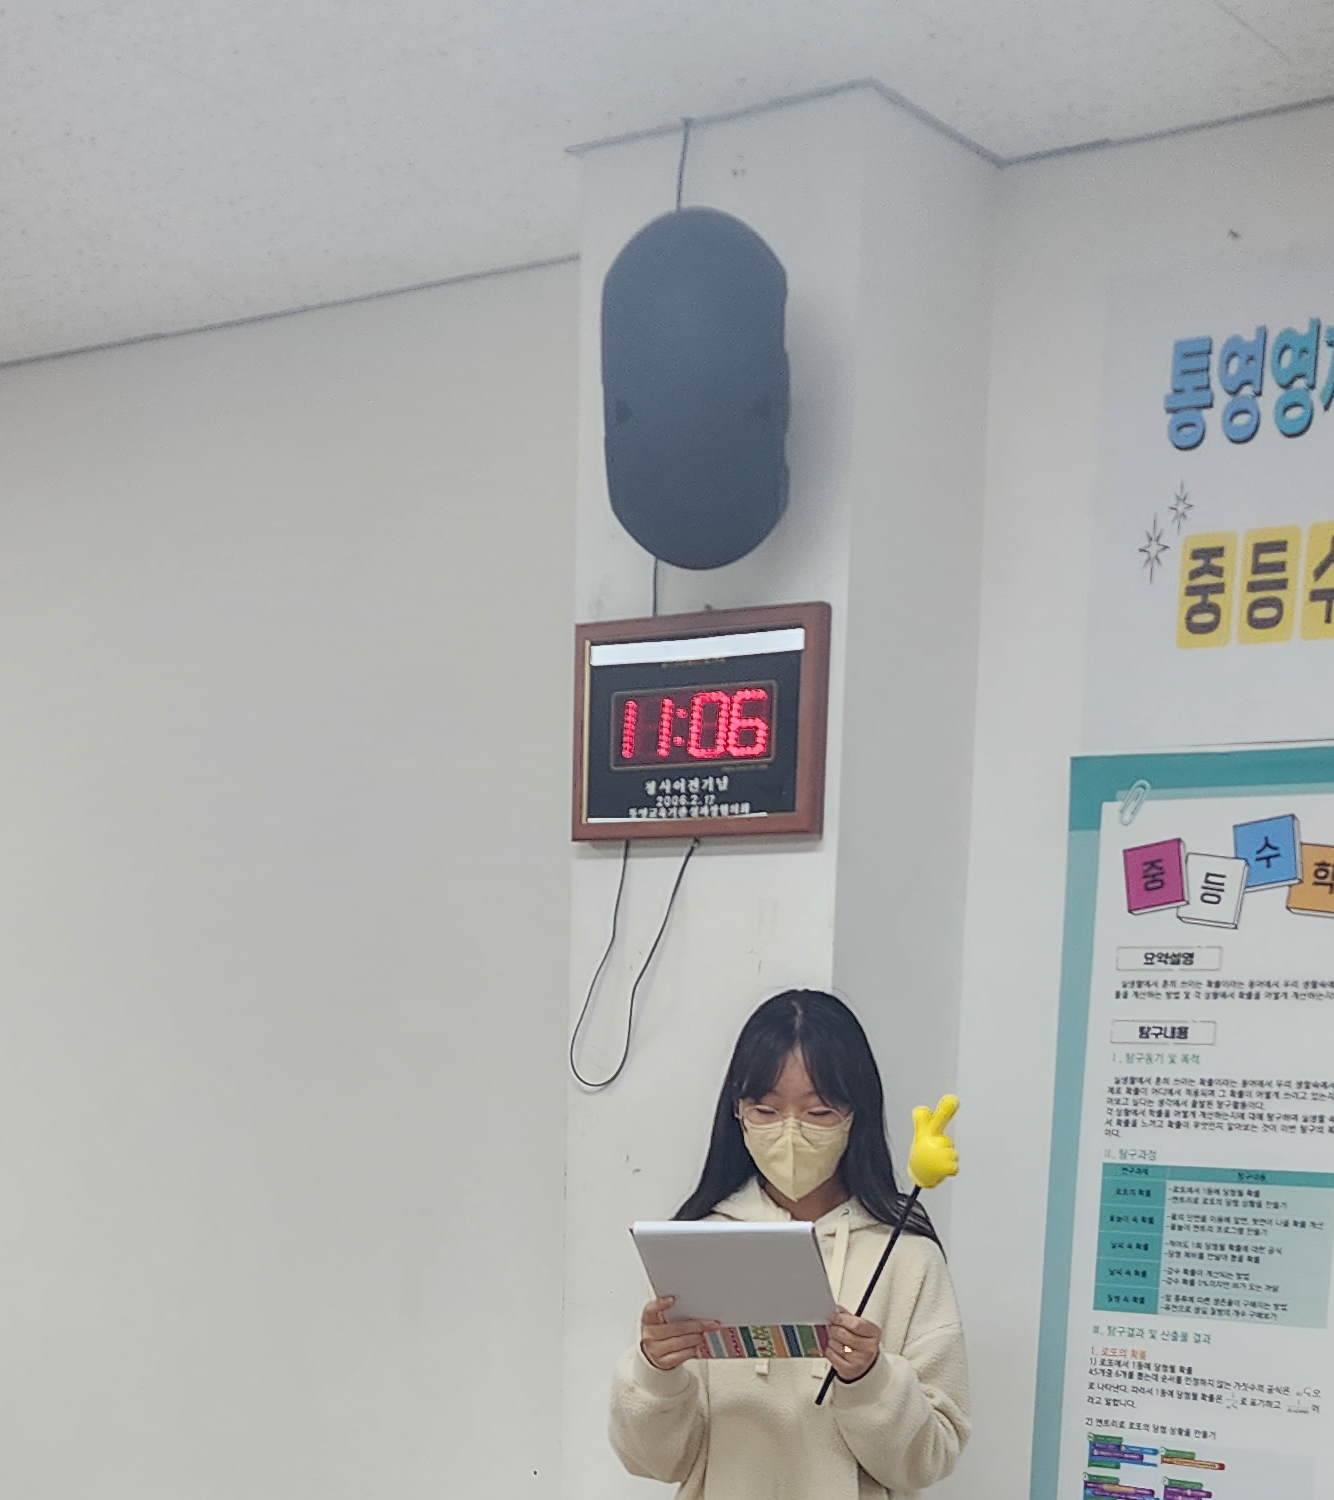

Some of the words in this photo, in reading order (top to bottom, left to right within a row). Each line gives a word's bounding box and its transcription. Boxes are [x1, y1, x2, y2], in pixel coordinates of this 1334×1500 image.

[621, 688, 768, 758] 11:06
[1143, 952, 1194, 965] 요약설명
[1139, 1026, 1188, 1039] 탐구내용
